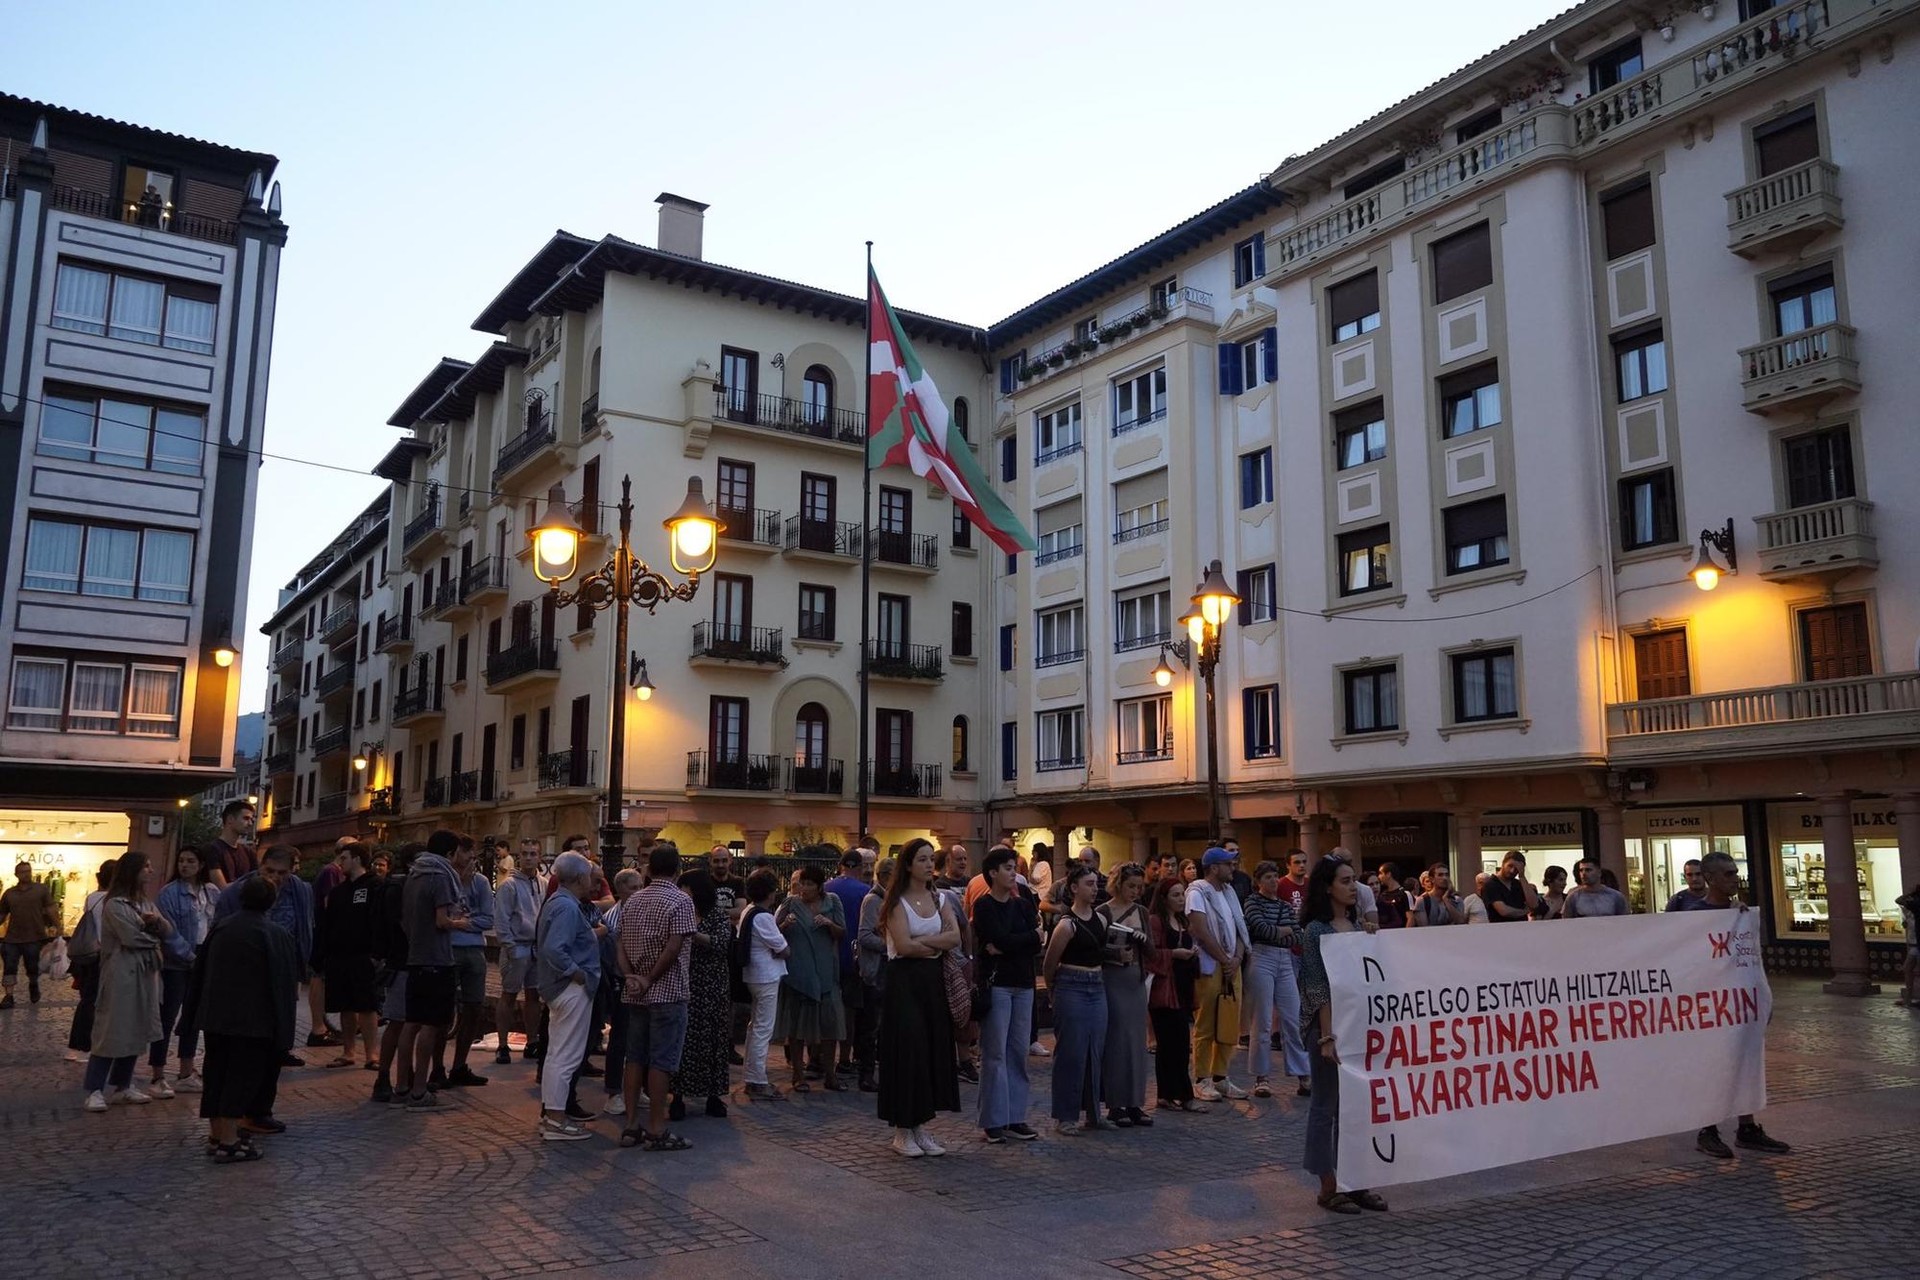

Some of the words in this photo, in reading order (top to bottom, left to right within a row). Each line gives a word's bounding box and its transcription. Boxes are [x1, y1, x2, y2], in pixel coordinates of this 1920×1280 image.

[1365, 1008, 1560, 1072] PALESTINAR
[1568, 987, 1759, 1043] HERRIAREKIN
[1367, 986, 1470, 1025] ISRAELGO
[1477, 977, 1561, 1013] ESTATUA
[1566, 968, 1673, 1002] HILTZAILEA
[1369, 1050, 1600, 1124] ELKARTASUNA
